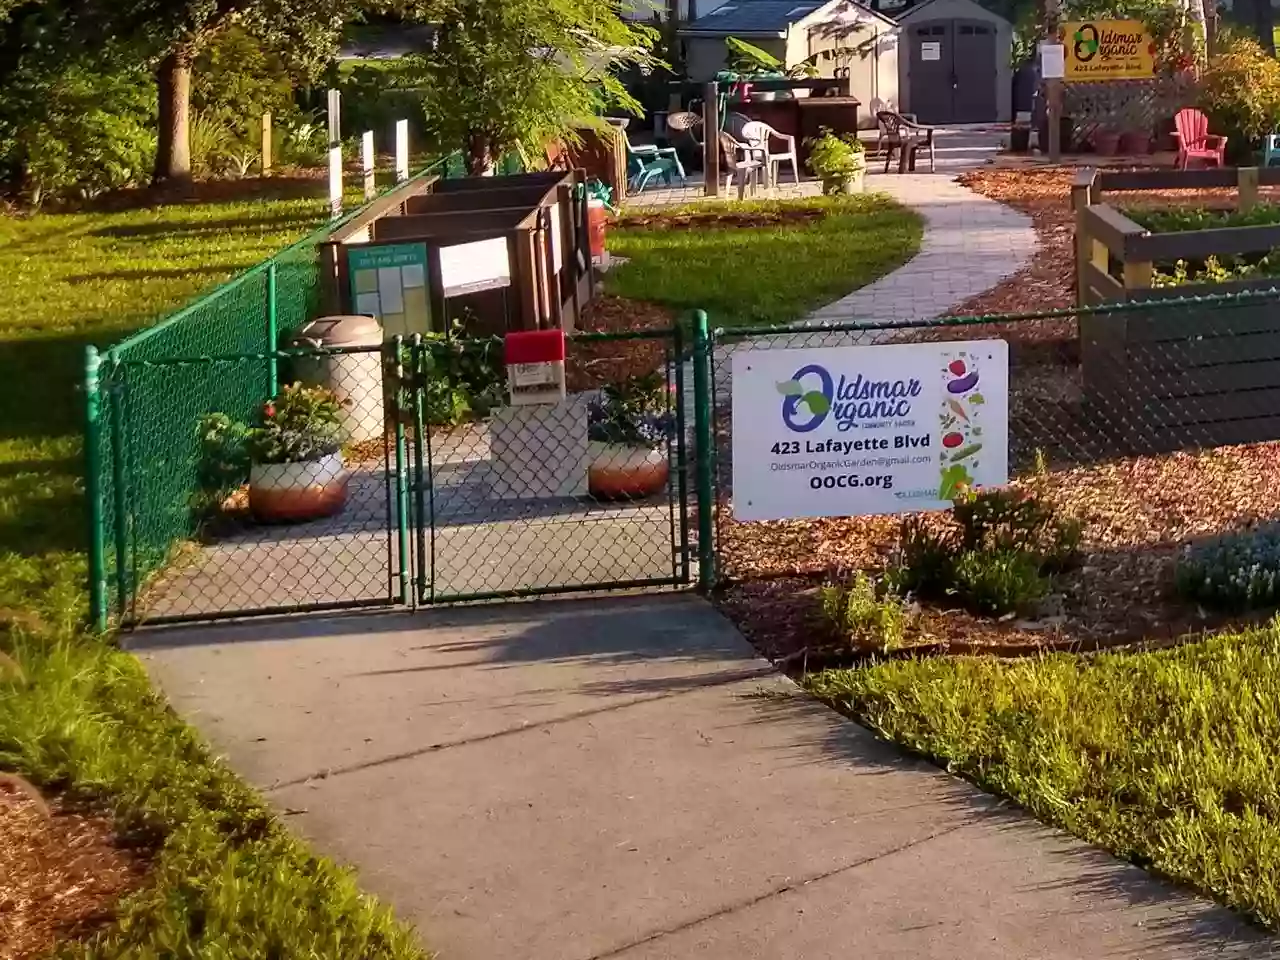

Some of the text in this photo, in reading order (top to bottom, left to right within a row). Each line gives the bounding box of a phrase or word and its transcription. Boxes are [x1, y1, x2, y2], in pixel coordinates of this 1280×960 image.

[771, 434, 930, 455] 423 Lafayette Blvd
[770, 454, 931, 471] OldsmarOrganicGarden@gmail.com
[810, 474, 893, 490] OOCG.org
